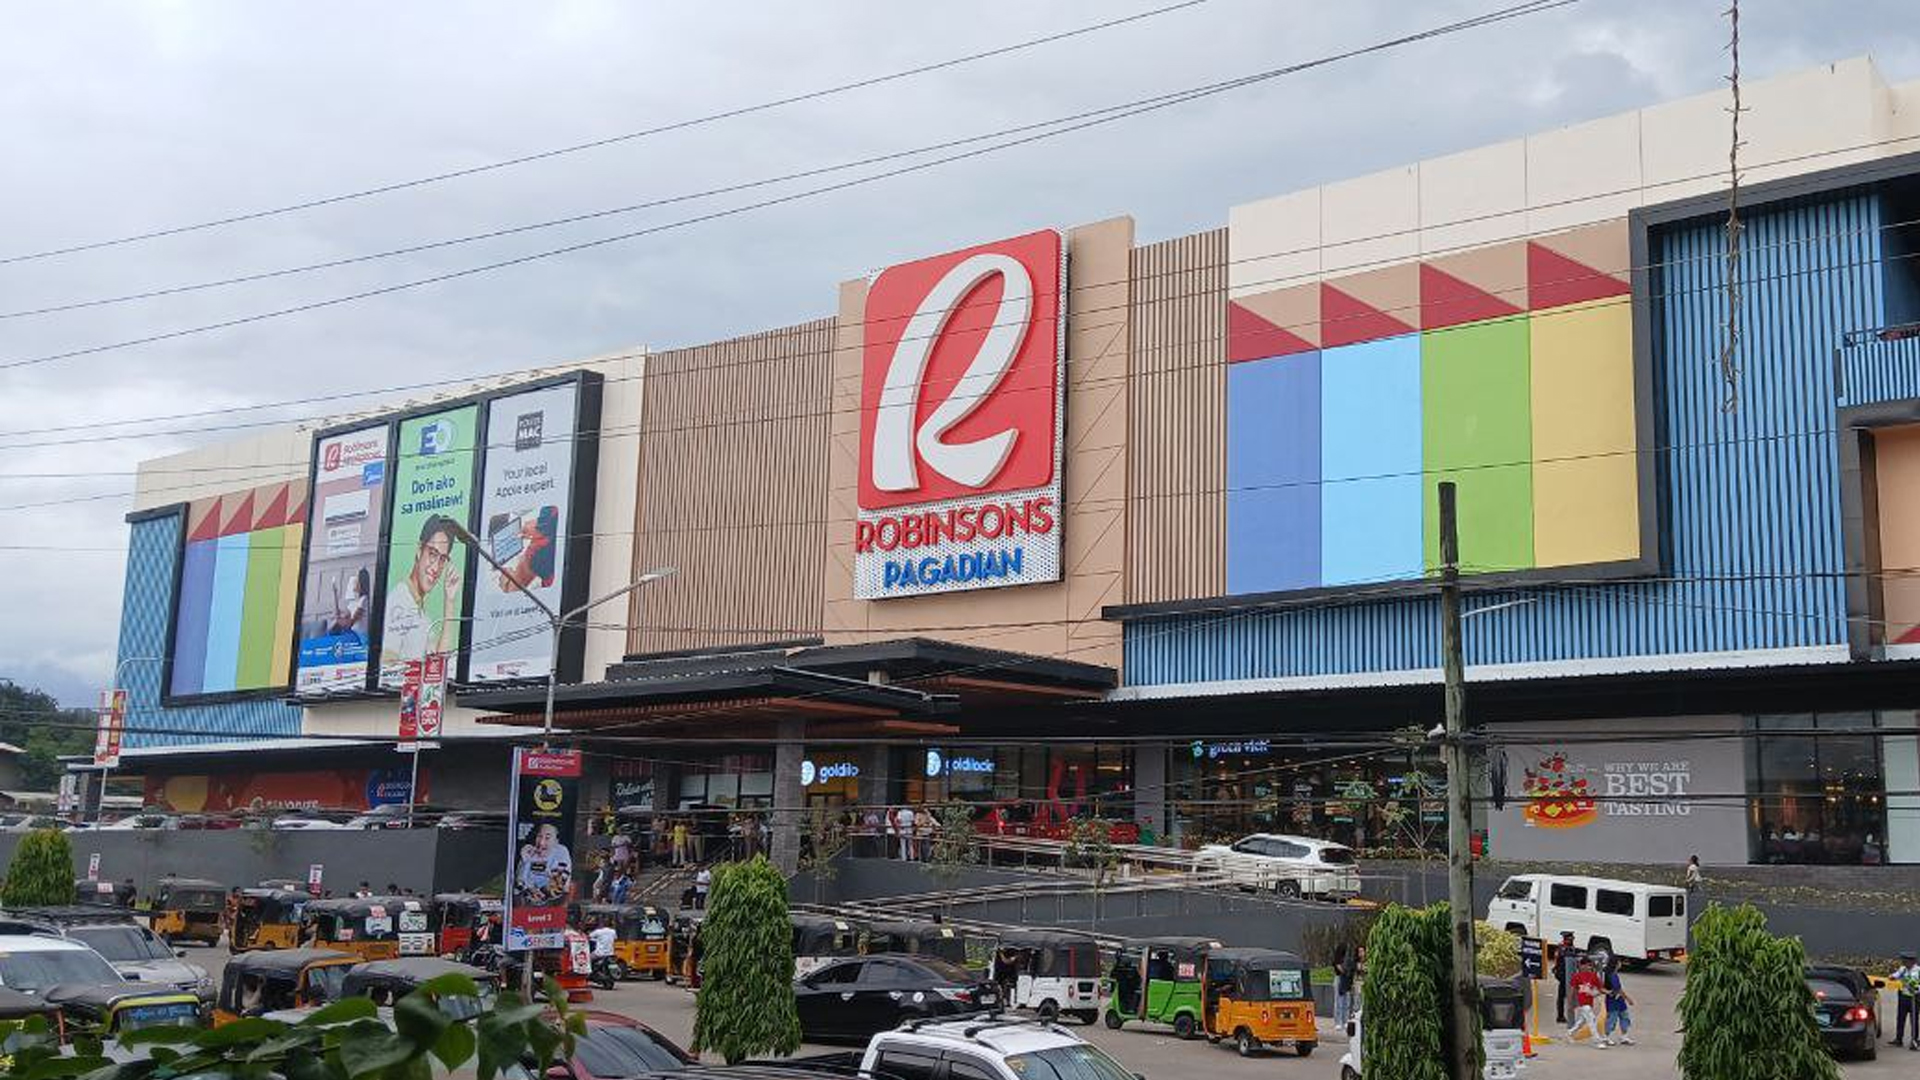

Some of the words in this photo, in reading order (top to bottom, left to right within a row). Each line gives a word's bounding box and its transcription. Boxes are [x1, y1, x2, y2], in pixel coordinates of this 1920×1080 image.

[525, 461, 548, 477] local
[435, 475, 456, 491] ako
[524, 477, 555, 494] expert
[401, 503, 413, 514] sa
[415, 490, 463, 512] malinaw!
[856, 498, 1054, 553] ROBINSONS
[883, 547, 1023, 589] PAGADIAN
[1604, 762, 1636, 773] WHY
[1637, 762, 1660, 772] WE
[1662, 760, 1690, 772] ARE
[1604, 772, 1690, 797] BEST
[1604, 801, 1690, 816] TASTING
